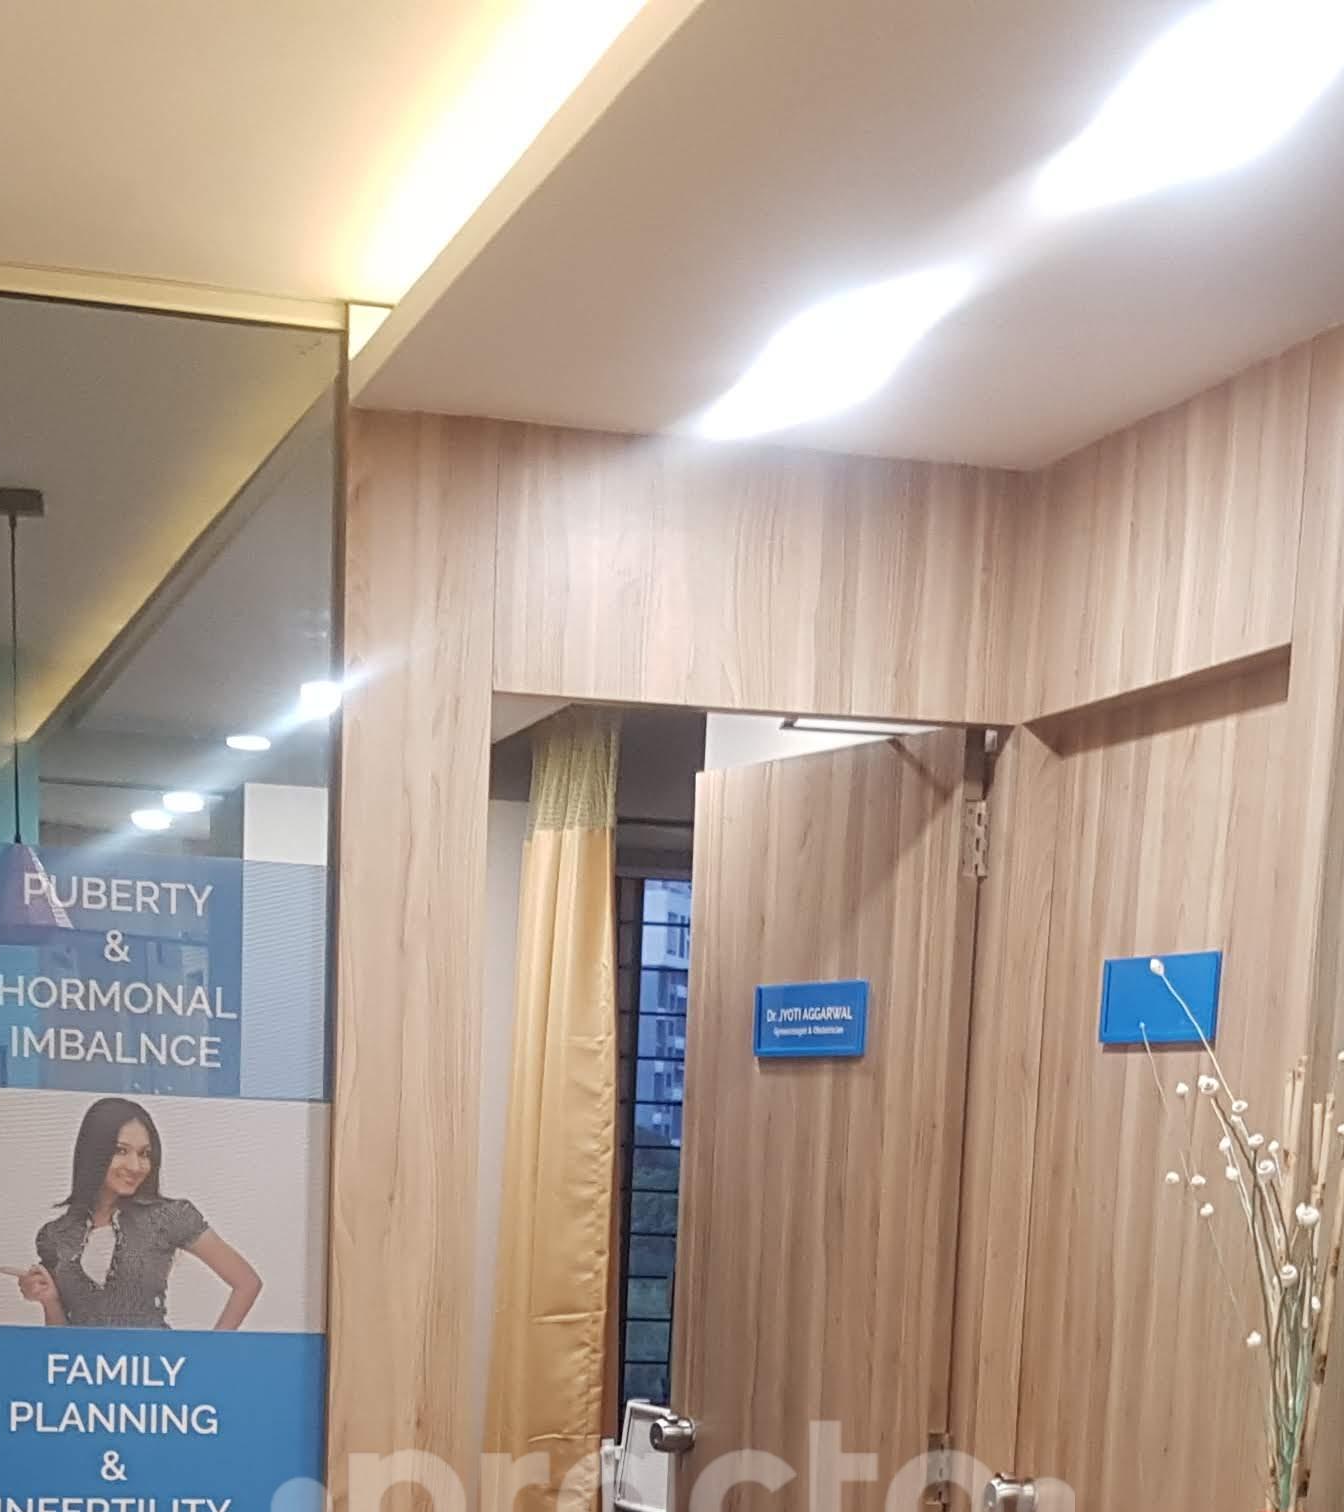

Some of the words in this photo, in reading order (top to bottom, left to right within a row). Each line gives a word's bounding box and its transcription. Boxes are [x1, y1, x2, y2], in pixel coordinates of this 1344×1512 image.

[22, 871, 213, 917] PUBERTY
[102, 929, 130, 963] &
[778, 1007, 801, 1022] JYOTI
[803, 1005, 853, 1020] AGGARWAL
[9, 1025, 223, 1068] IMBALNCE
[46, 1353, 186, 1387] FAMILY
[8, 1401, 219, 1435] PLANNING
[99, 1450, 128, 1482] &
